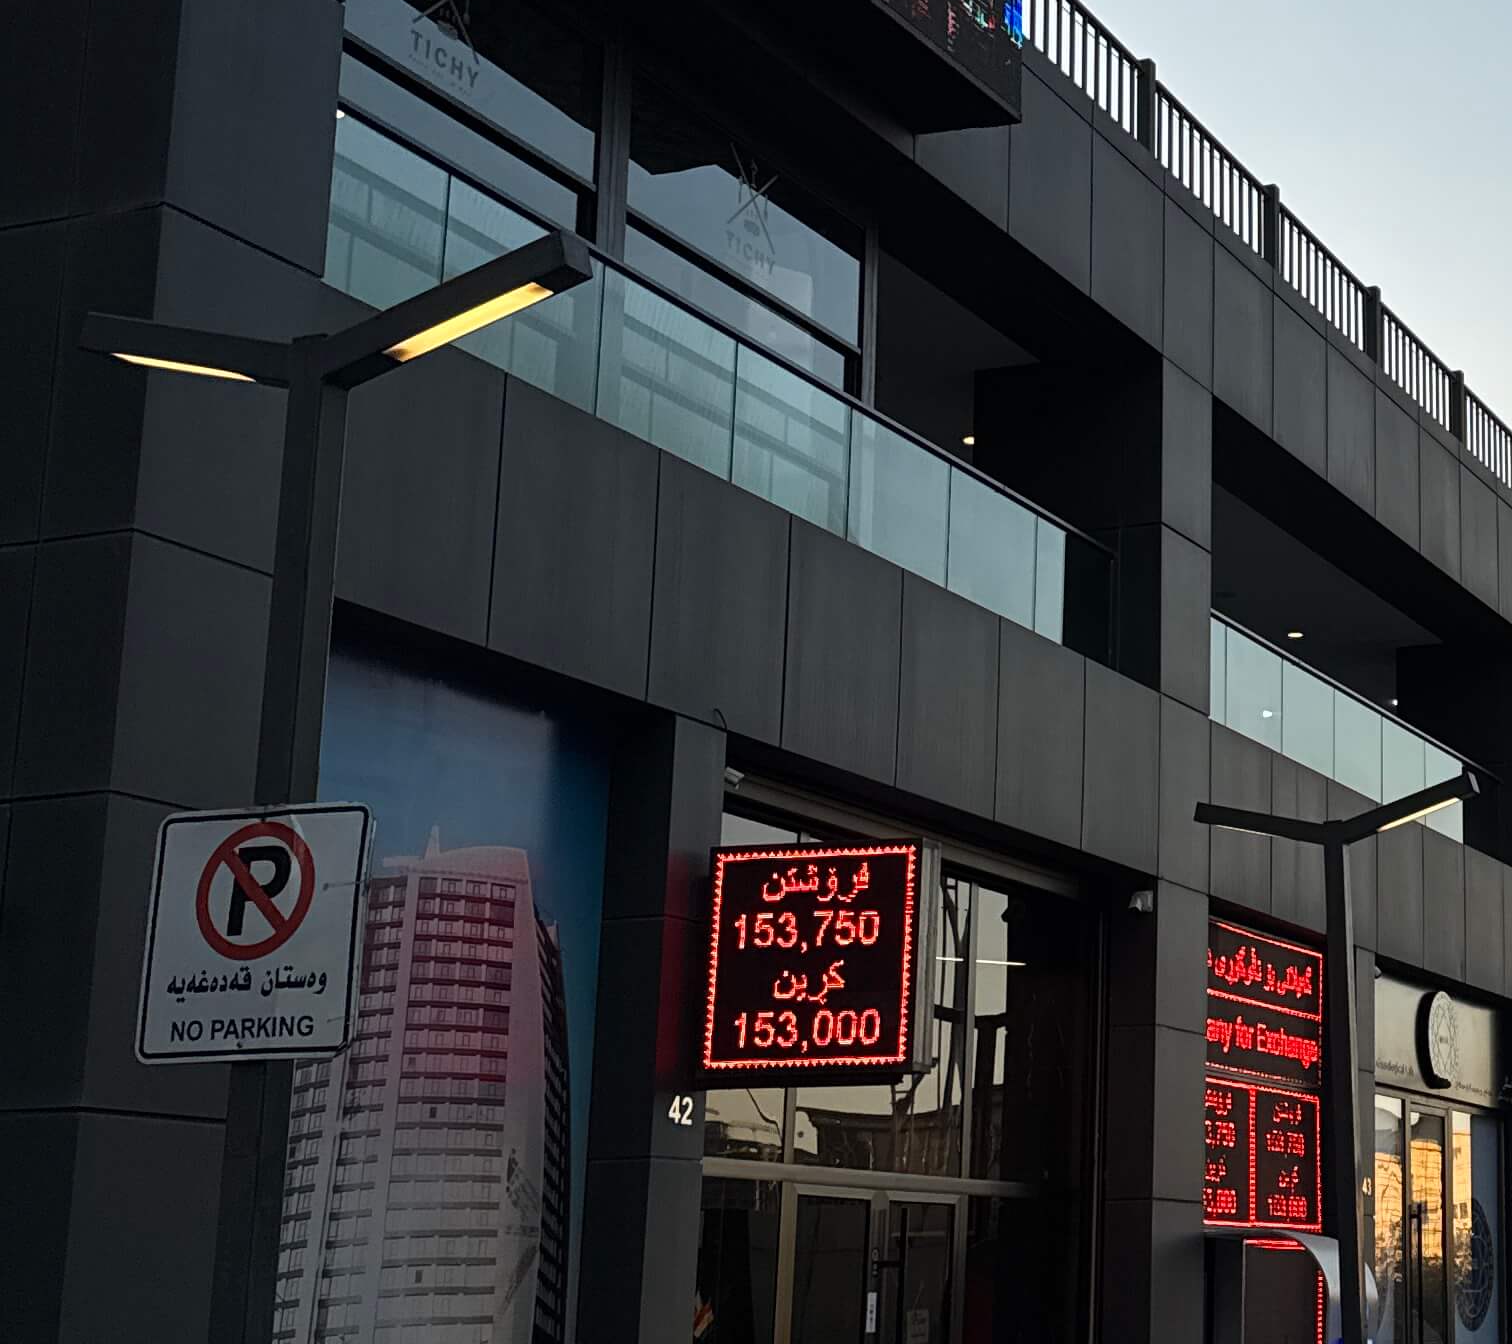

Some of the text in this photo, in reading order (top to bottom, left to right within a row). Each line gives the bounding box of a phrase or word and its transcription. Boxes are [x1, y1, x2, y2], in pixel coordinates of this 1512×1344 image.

[411, 28, 478, 88] TICHY
[725, 230, 776, 275] TICHY
[734, 910, 880, 953] 153,750
[170, 1015, 314, 1042] NO PARKING
[734, 1009, 881, 1053] 153,000
[1235, 1015, 1254, 1050] for
[1257, 1022, 1319, 1070] Exchange
[668, 1095, 693, 1126] 42
[1362, 1176, 1372, 1195] 43
